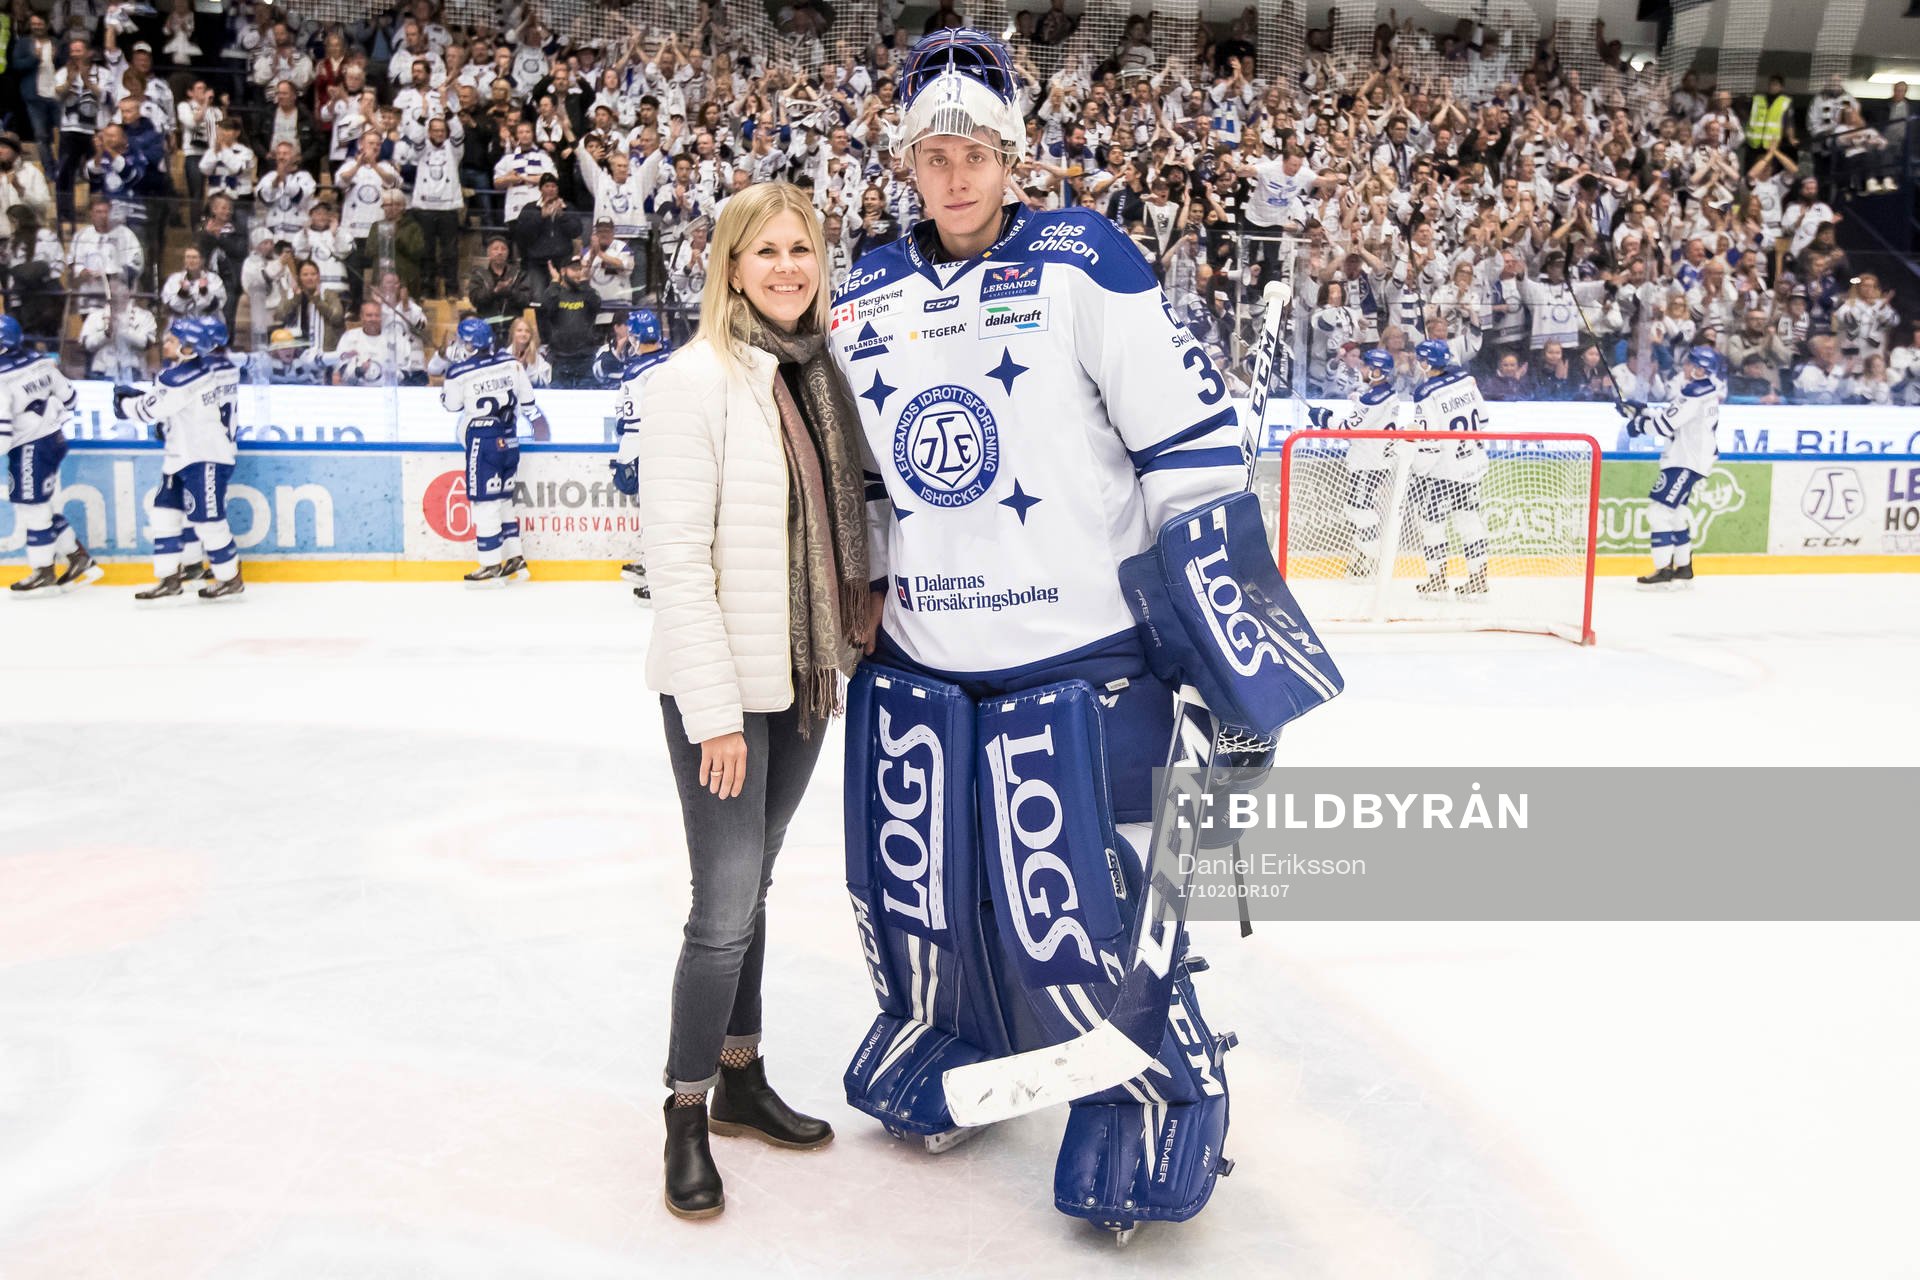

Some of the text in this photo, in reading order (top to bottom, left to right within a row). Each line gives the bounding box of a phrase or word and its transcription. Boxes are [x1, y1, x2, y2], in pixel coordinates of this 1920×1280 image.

[1041, 221, 1086, 238] clas
[1028, 237, 1100, 266] ohlson
[983, 279, 1038, 295] LEKSANDS
[858, 290, 904, 308] Bergkvist
[925, 298, 959, 310] CCM
[858, 304, 889, 320] Insjön
[985, 309, 1042, 327] dalakraft
[921, 323, 966, 339] TEGERA
[844, 334, 894, 353] ERLANDSSON
[895, 386, 998, 481] LEKSANDS IDROTTSFÖRENING
[920, 480, 985, 506] ISHOCKEY
[915, 574, 985, 593] Dalarnas
[917, 585, 1059, 612] Försäkringsbolag
[1185, 544, 1284, 677] LOGS
[877, 705, 947, 931] LOGS
[985, 724, 1097, 967] LOGS
[852, 1024, 886, 1077] PREMIER
[1158, 1119, 1178, 1183] PREMIER
